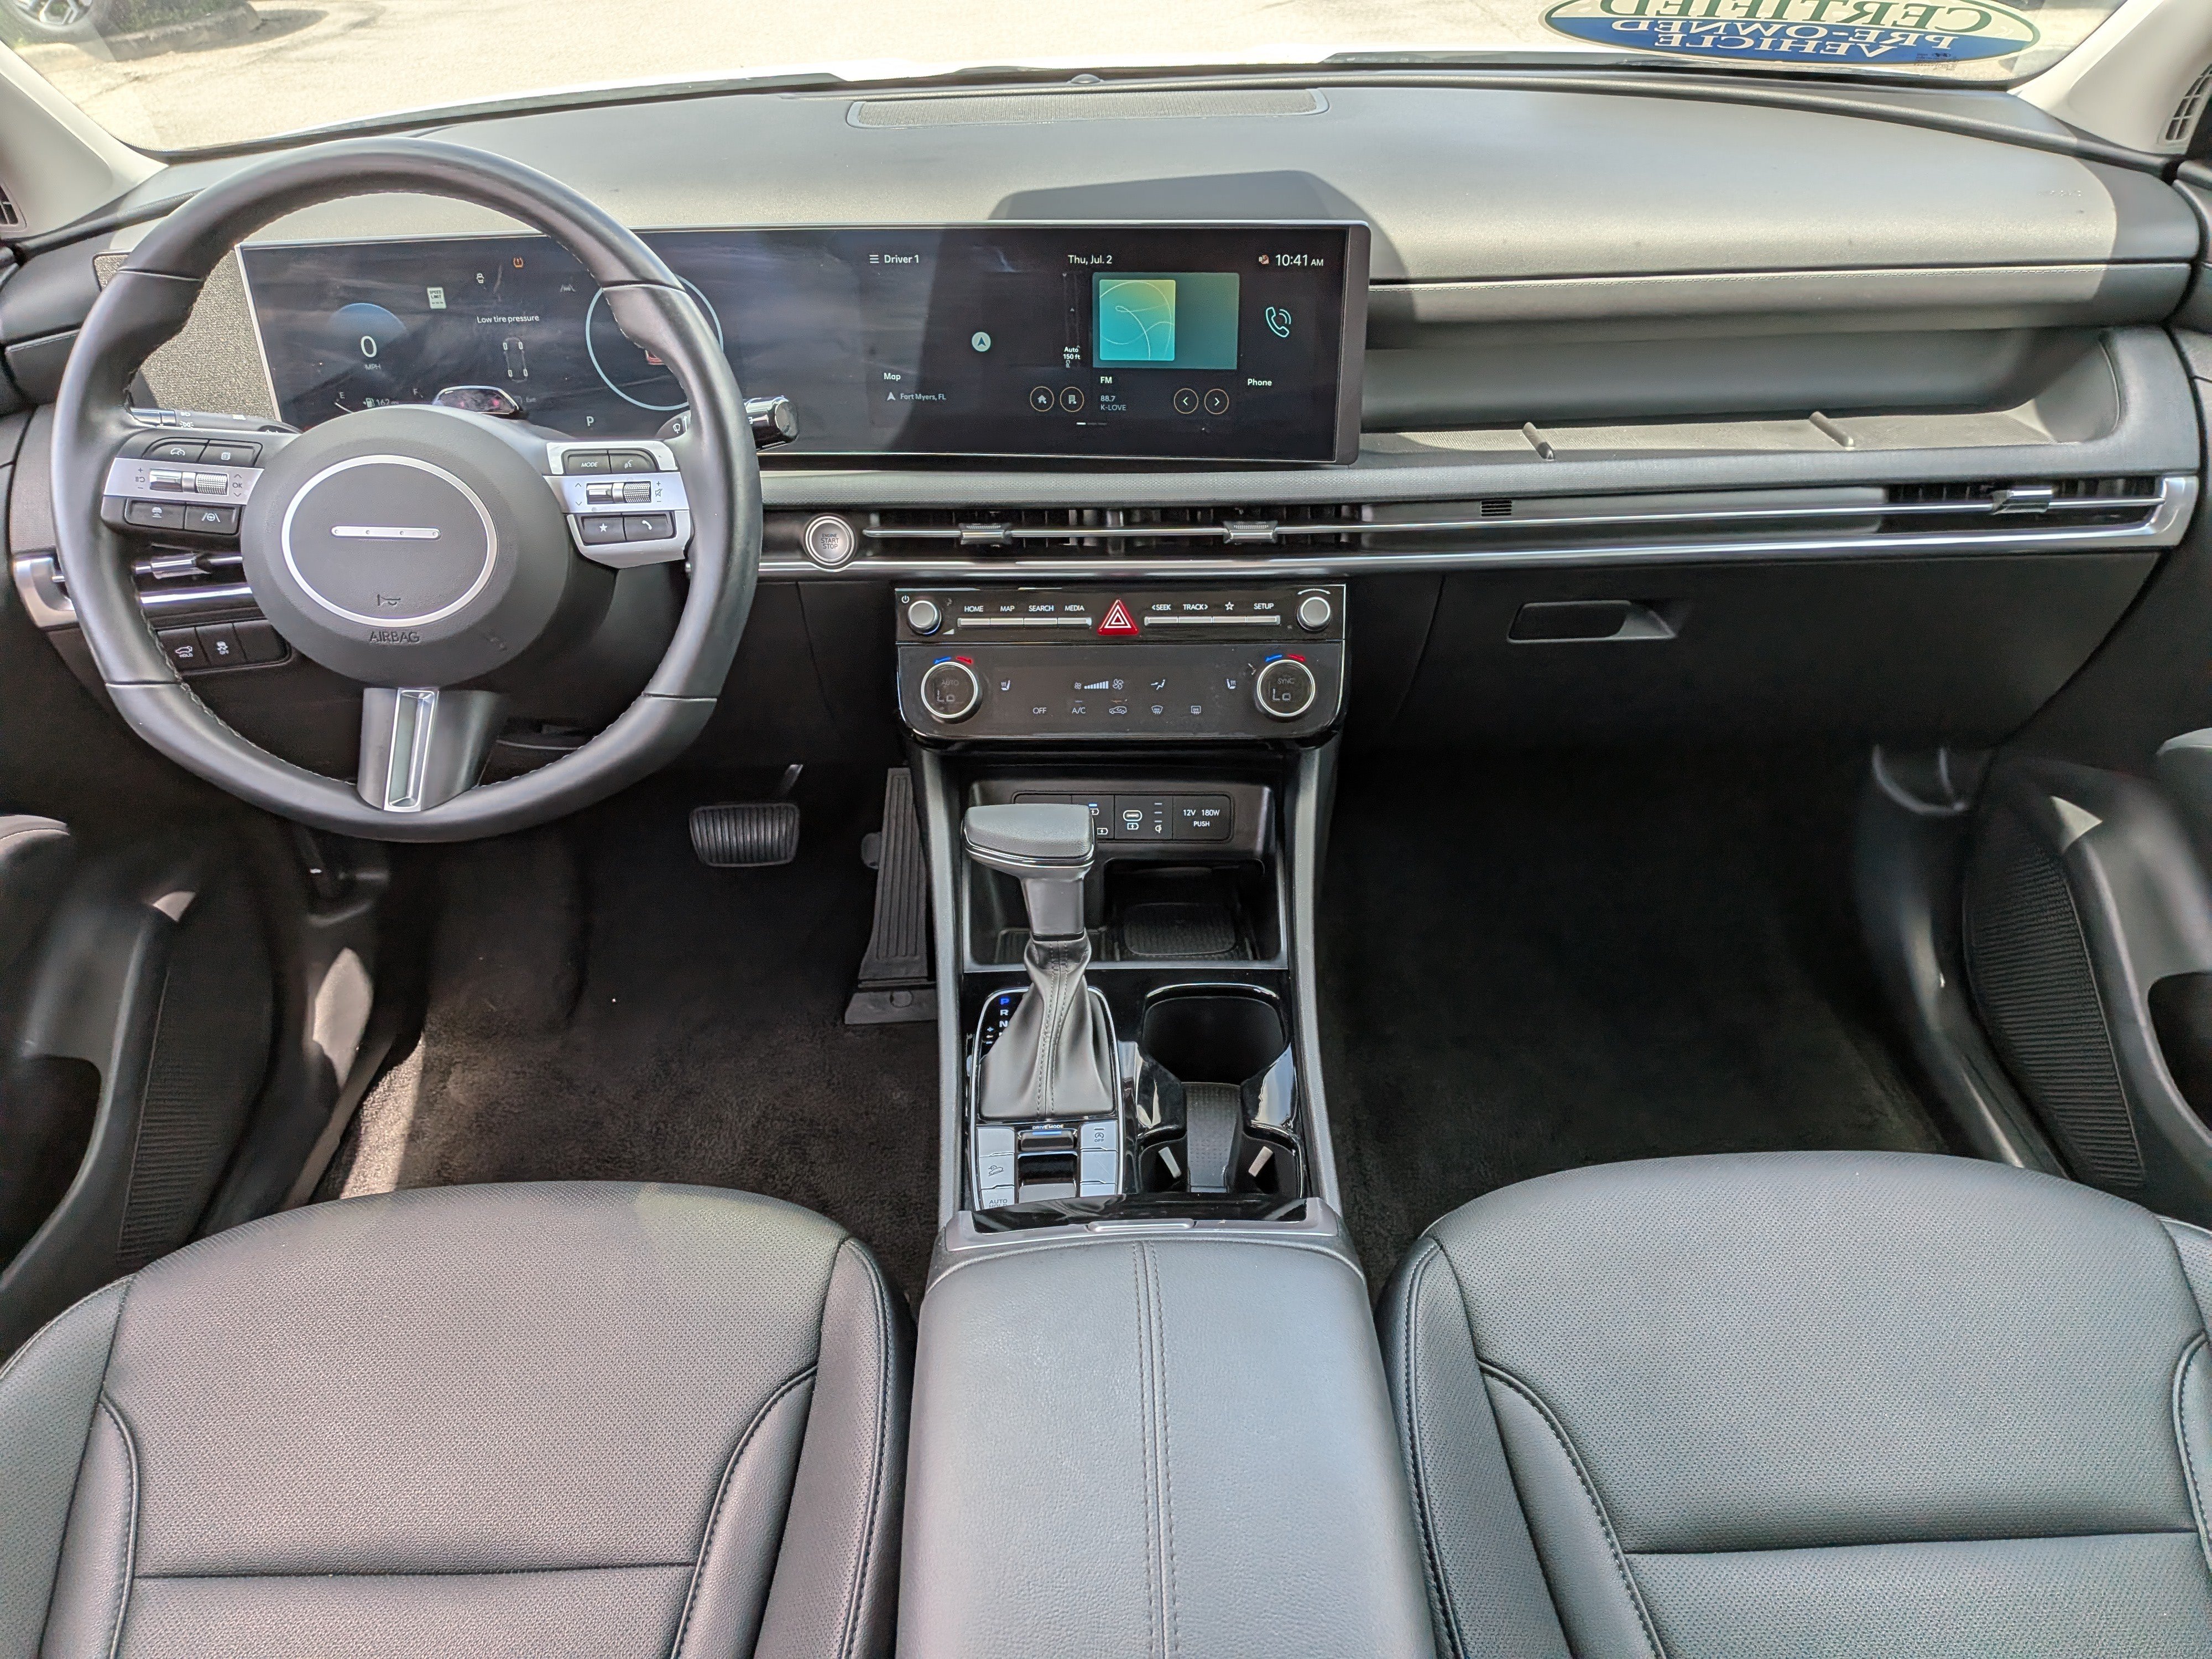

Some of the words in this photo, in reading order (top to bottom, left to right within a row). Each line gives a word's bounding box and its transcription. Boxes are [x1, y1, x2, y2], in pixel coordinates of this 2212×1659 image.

[884, 254, 912, 264] Driver
[914, 254, 919, 264] 1
[1068, 254, 1088, 266] Thu,
[1089, 254, 1105, 265] Jul.
[1106, 255, 1113, 264] 2
[1275, 254, 1309, 267] 10:41
[1311, 258, 1324, 267] AM
[508, 315, 540, 324] pressure
[361, 335, 377, 358] 0
[883, 372, 901, 382] Map
[1247, 378, 1272, 387] Phone
[375, 398, 390, 406] 162
[586, 416, 594, 426] P
[369, 630, 420, 644] AIRBAG
[1272, 688, 1291, 702] Lo
